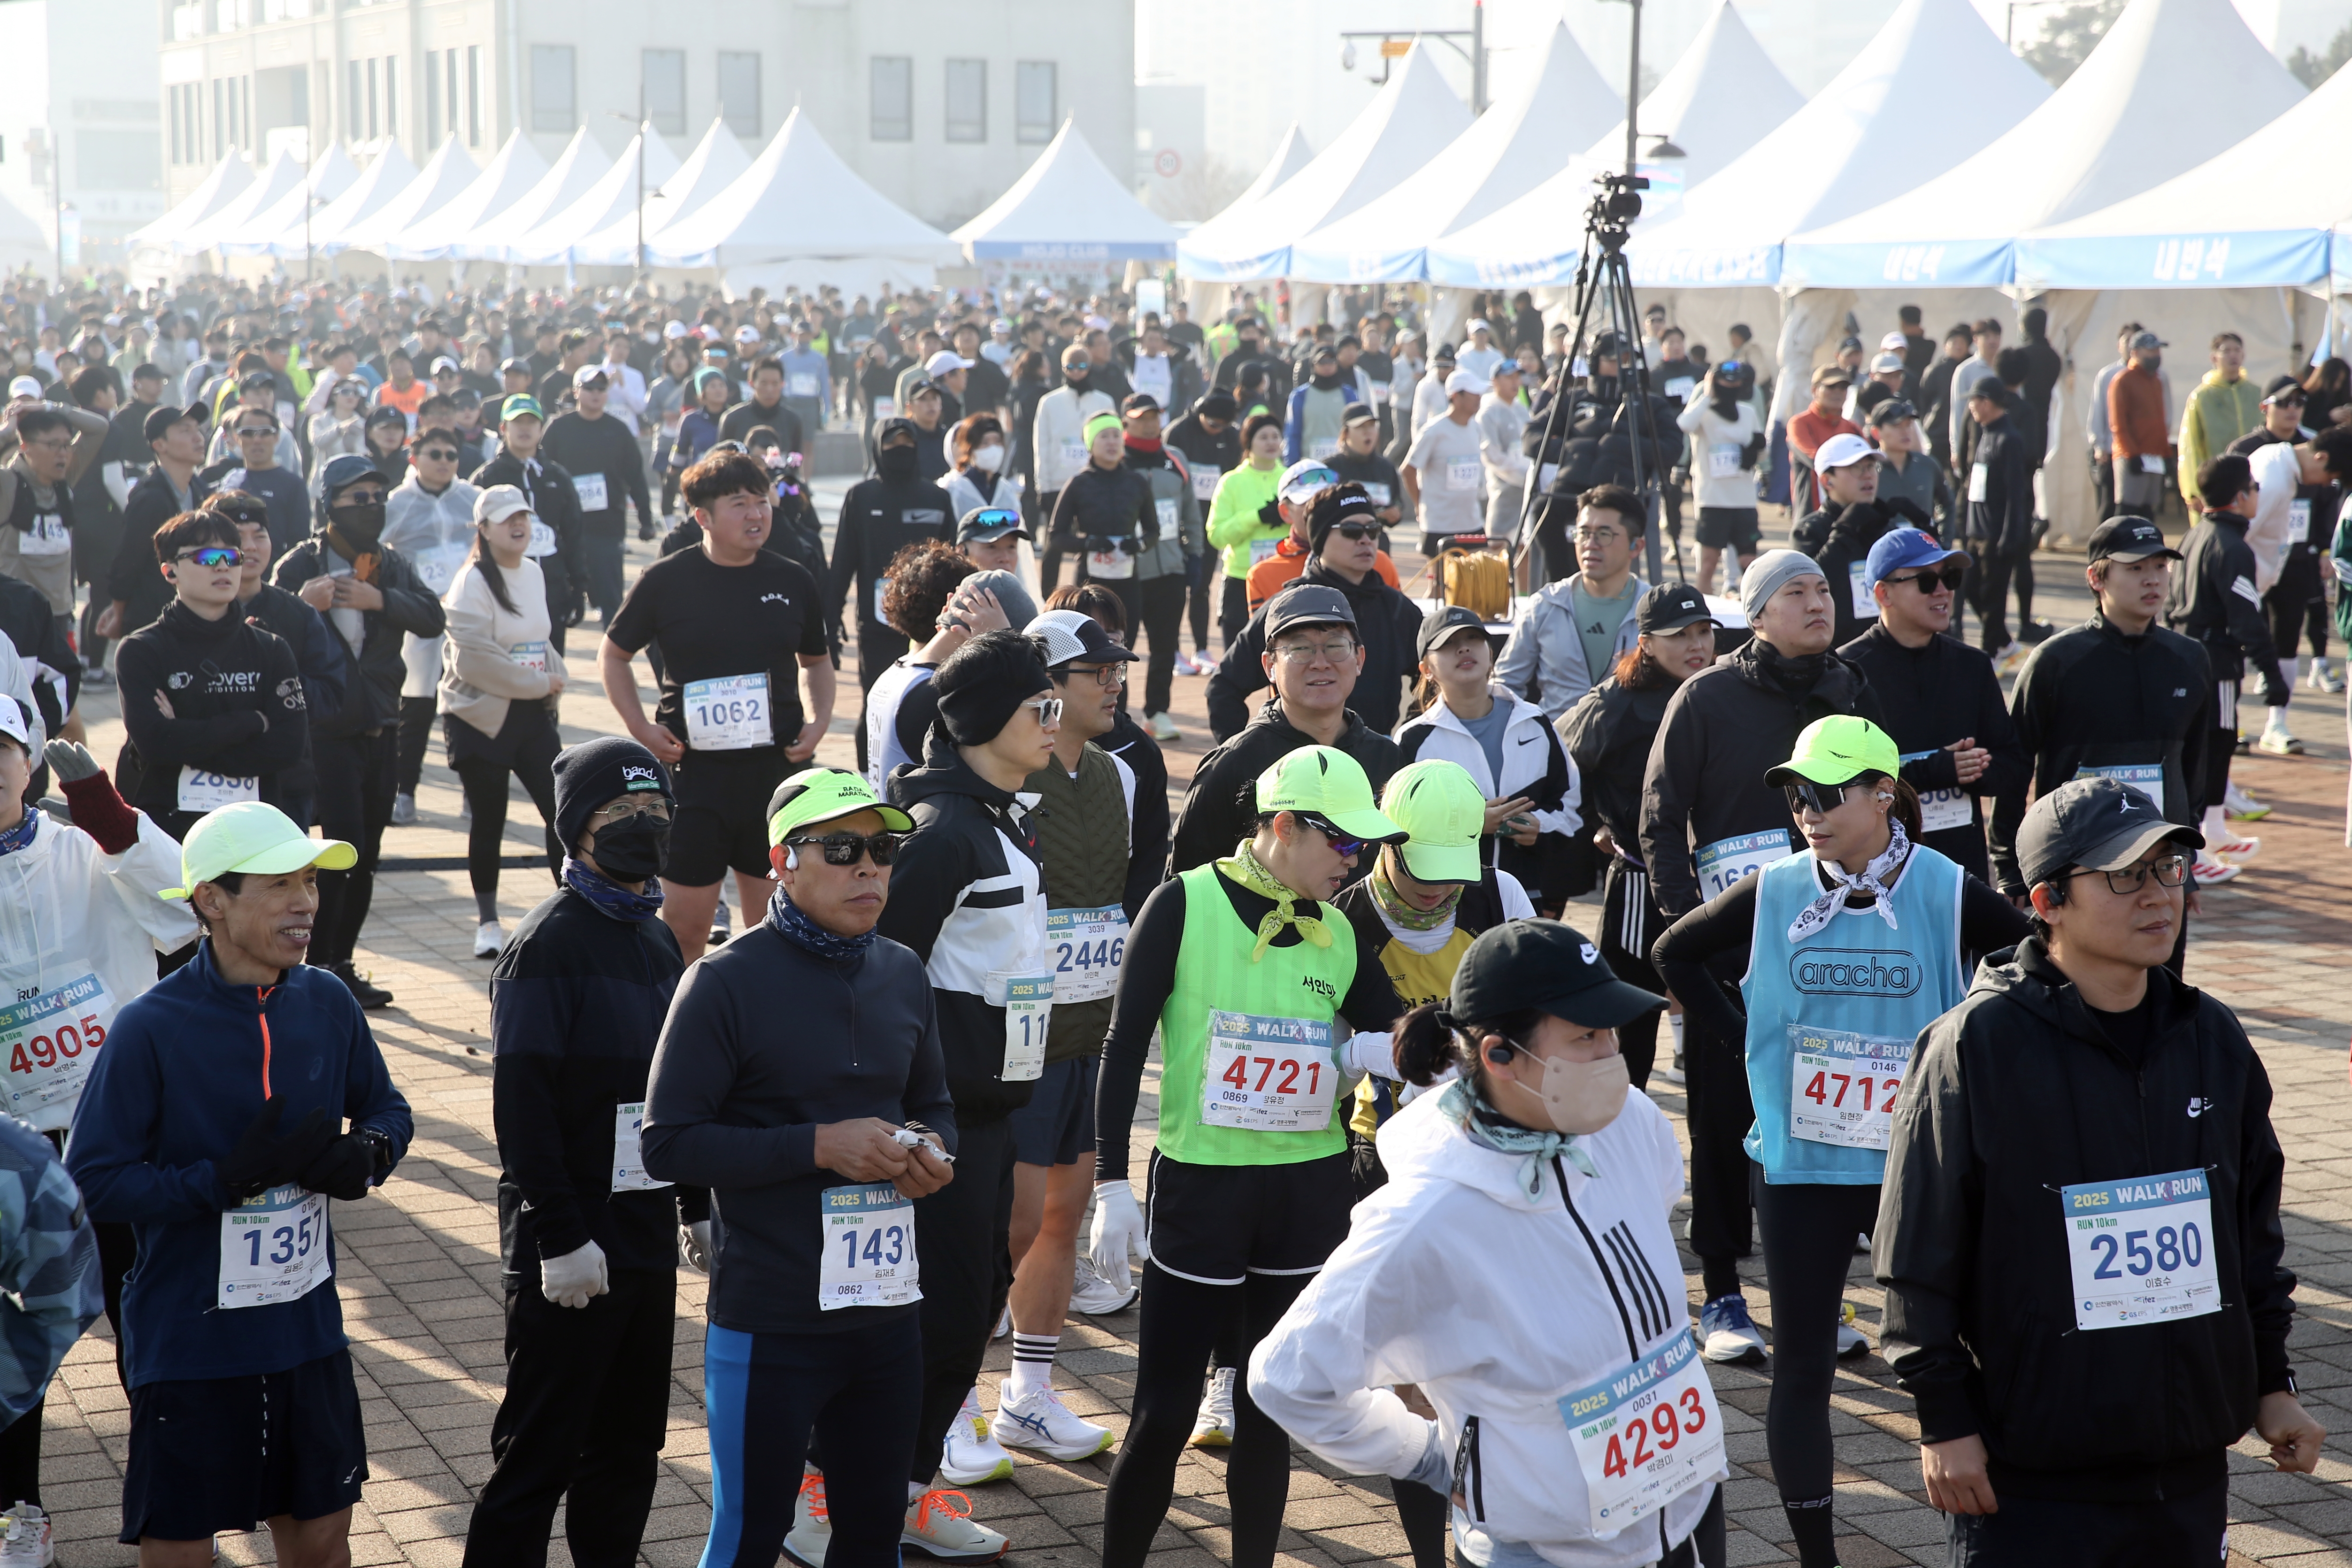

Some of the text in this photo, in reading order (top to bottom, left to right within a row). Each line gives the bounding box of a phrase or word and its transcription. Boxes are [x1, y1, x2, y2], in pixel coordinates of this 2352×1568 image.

[697, 699, 761, 727] 1062
[838, 790, 872, 799] MARATHON
[1700, 832, 1784, 862] 2025 WALK&RUN
[1047, 915, 1068, 925] 2025
[1088, 925, 1105, 934] 3039
[1056, 937, 1125, 973] 2446
[1799, 956, 1909, 989] aracha
[1013, 985, 1034, 995] 2025
[1302, 975, 1336, 999] 서인마
[0, 1015, 13, 1026] 25
[1222, 1020, 1250, 1033] 2025
[5, 1030, 23, 1042] 10km
[9, 1014, 107, 1075] 4905
[1220, 1039, 1252, 1051] RUN 10km
[1803, 1037, 1914, 1060] 2025 WALK&RUN
[1801, 1055, 1829, 1068] RUN 10km
[1871, 1061, 1897, 1072] 0146
[1222, 1054, 1321, 1095] 4721
[1222, 1091, 1248, 1103] 0869
[1805, 1071, 1901, 1114] 4712
[624, 1106, 636, 1114] RUN
[1840, 1112, 1863, 1121] 임현정
[2073, 1176, 2202, 1207] 2025 WALK&RUN
[302, 1197, 317, 1214] 0162
[830, 1194, 860, 1206] 2025
[232, 1215, 270, 1225] RUN 10km
[832, 1216, 863, 1225] RUN 10km
[2076, 1217, 2118, 1230] RUN 10km
[243, 1205, 322, 1266] 1357
[842, 1223, 914, 1268] 1431
[2090, 1222, 2202, 1280] 2580
[875, 1268, 896, 1278] 김재호
[237, 1283, 262, 1291] 인천광역시
[2145, 1276, 2171, 1289] 이효수
[838, 1285, 862, 1295] 0862
[2095, 1299, 2123, 1308] 인천광역시
[1571, 1335, 1691, 1417] 2025 WALK&RUN
[1632, 1390, 1657, 1413] 0031
[1580, 1415, 1617, 1440] RUN 10km
[1603, 1386, 1706, 1479] 4293
[1646, 1453, 1674, 1473] 박경미
[1648, 1479, 1660, 1491] ifez
[1639, 1497, 1655, 1511] GS EPS
